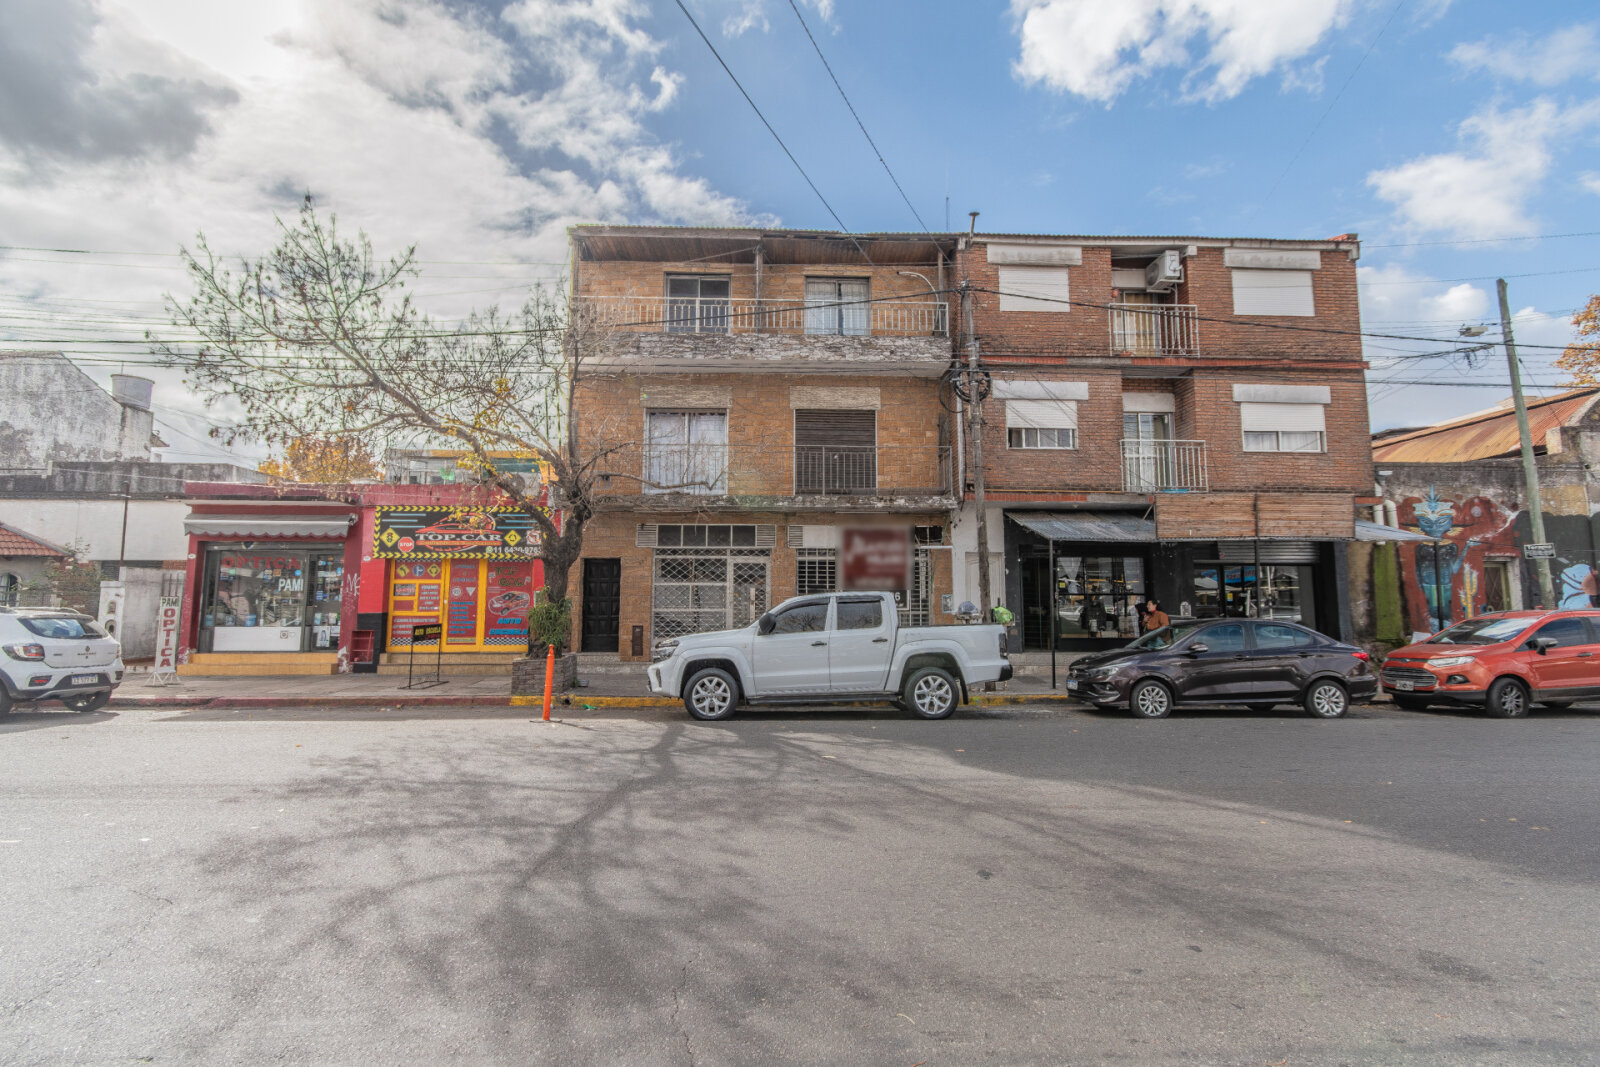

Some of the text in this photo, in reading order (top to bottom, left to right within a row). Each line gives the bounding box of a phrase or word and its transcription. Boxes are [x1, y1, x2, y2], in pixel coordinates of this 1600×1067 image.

[415, 533, 502, 541] TOP.CAR
[222, 556, 301, 569] OPTICA
[278, 578, 304, 592] PAMI
[162, 598, 179, 607] PAMI
[160, 608, 176, 667] OPTICA
